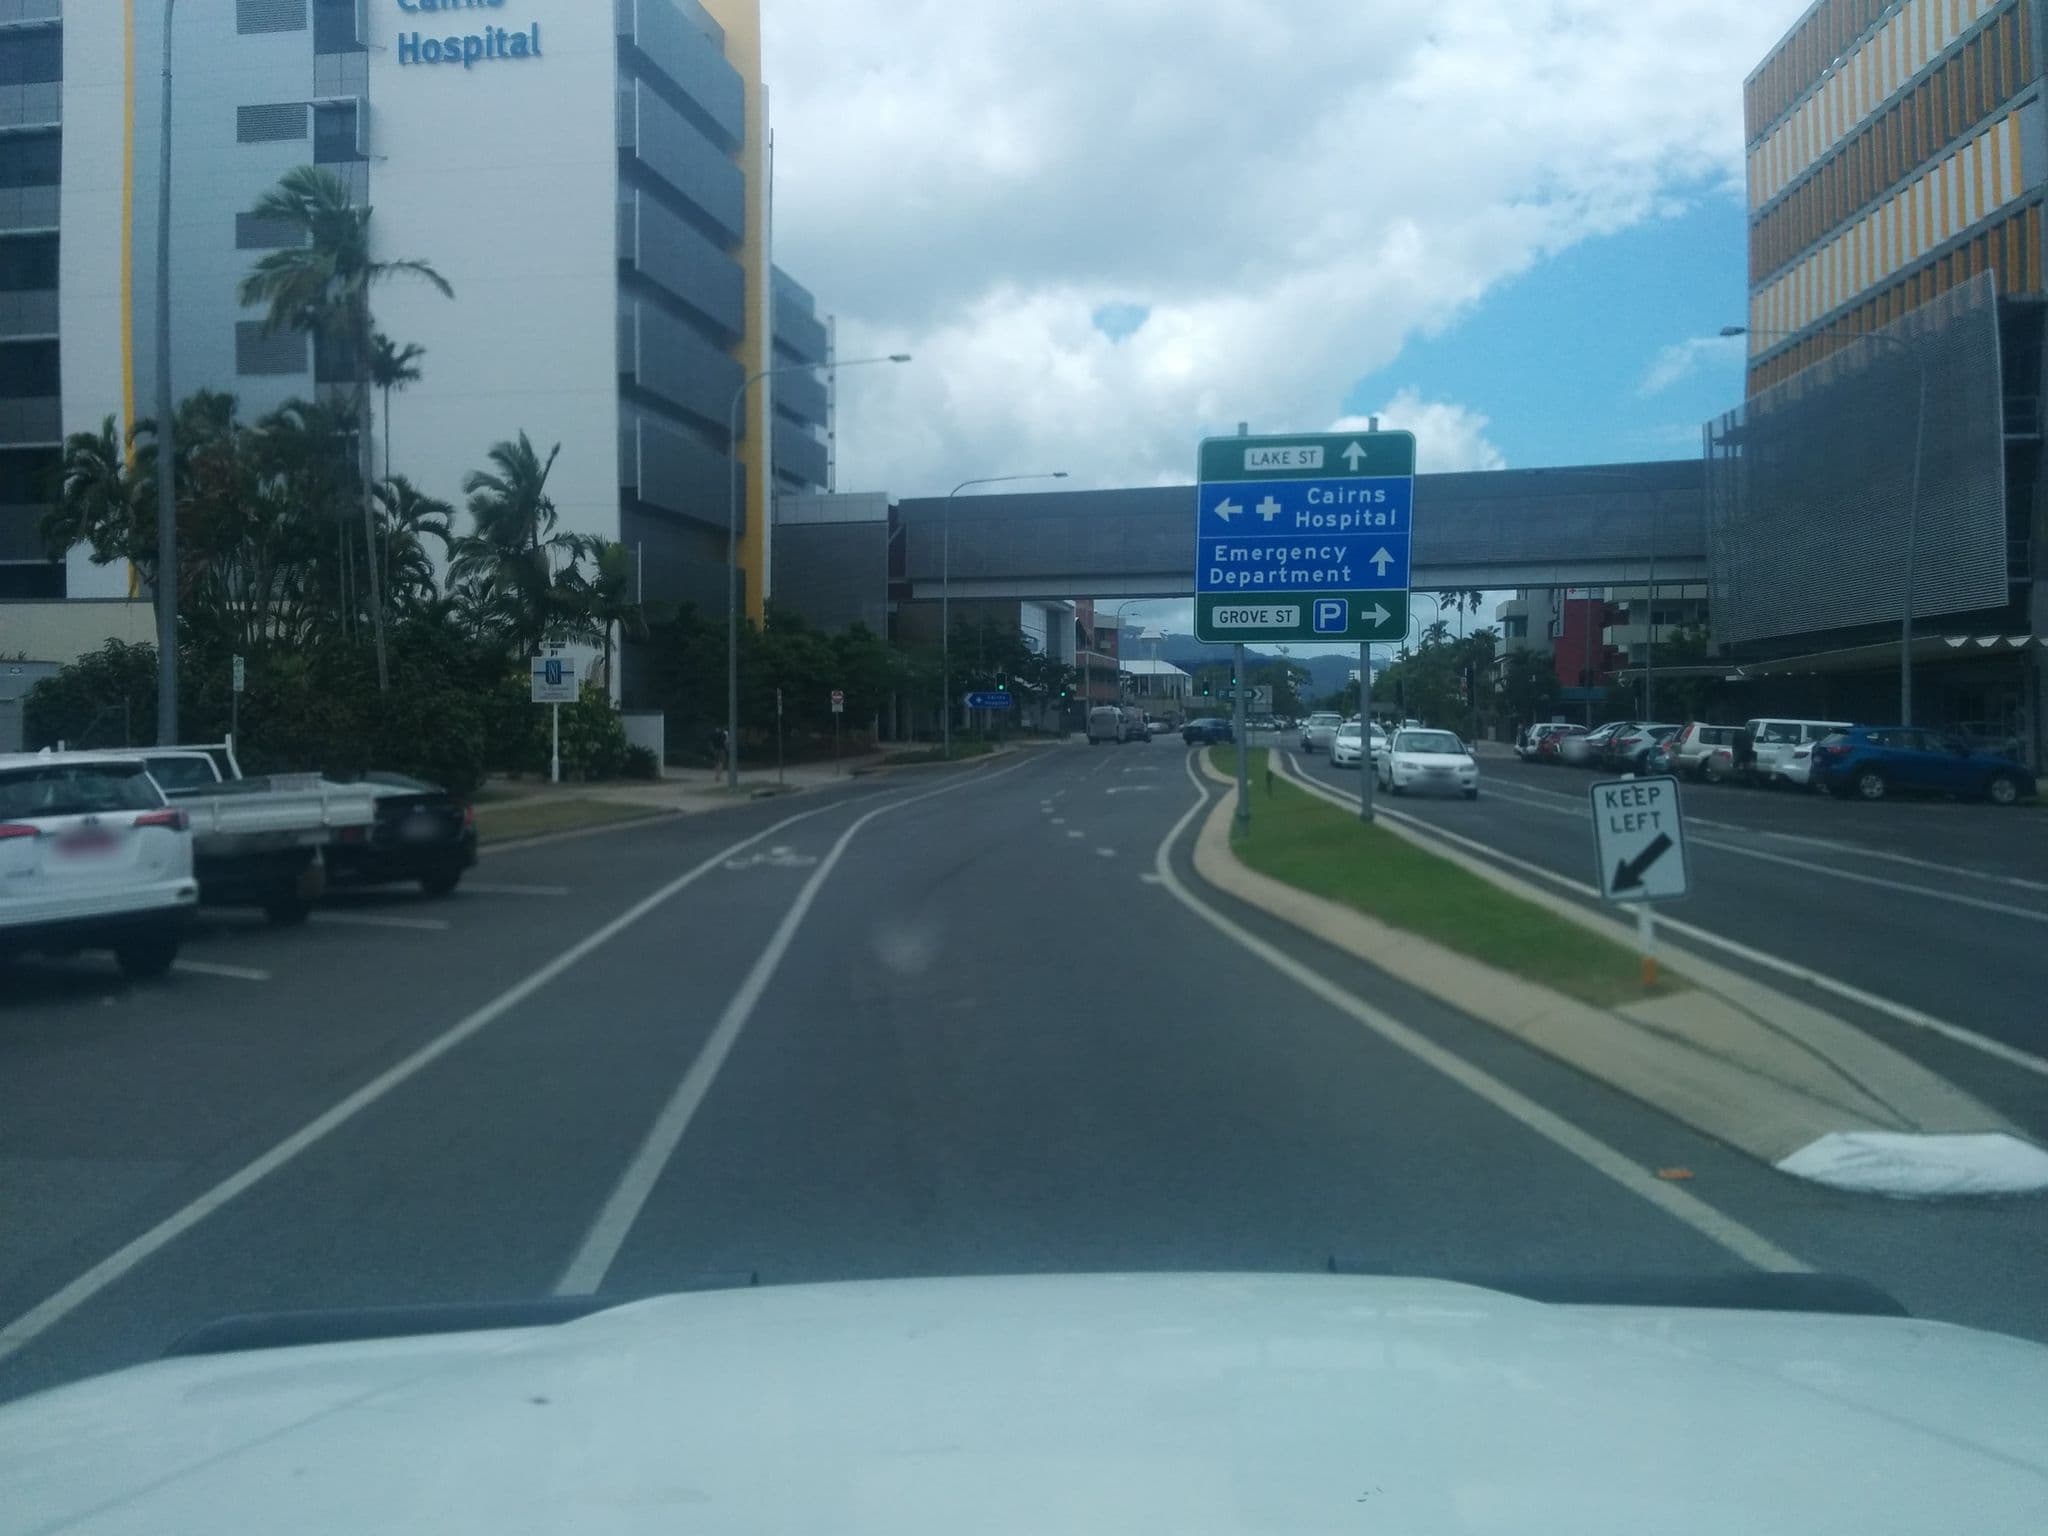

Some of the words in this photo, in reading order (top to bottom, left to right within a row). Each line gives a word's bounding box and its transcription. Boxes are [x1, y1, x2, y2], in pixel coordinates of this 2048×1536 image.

[398, 20, 541, 69] Hospital
[1250, 450, 1290, 466] LAKE
[1299, 450, 1317, 465] ST
[1306, 487, 1386, 505] Cairns
[1295, 509, 1396, 530] Hospital
[1215, 545, 1347, 566] Emergency
[1210, 566, 1352, 588] Department
[1219, 610, 1268, 624] GROVE
[1275, 609, 1294, 623] ST
[1319, 603, 1342, 629] P
[1605, 786, 1660, 808] KEEP
[1610, 811, 1661, 833] LEFT
